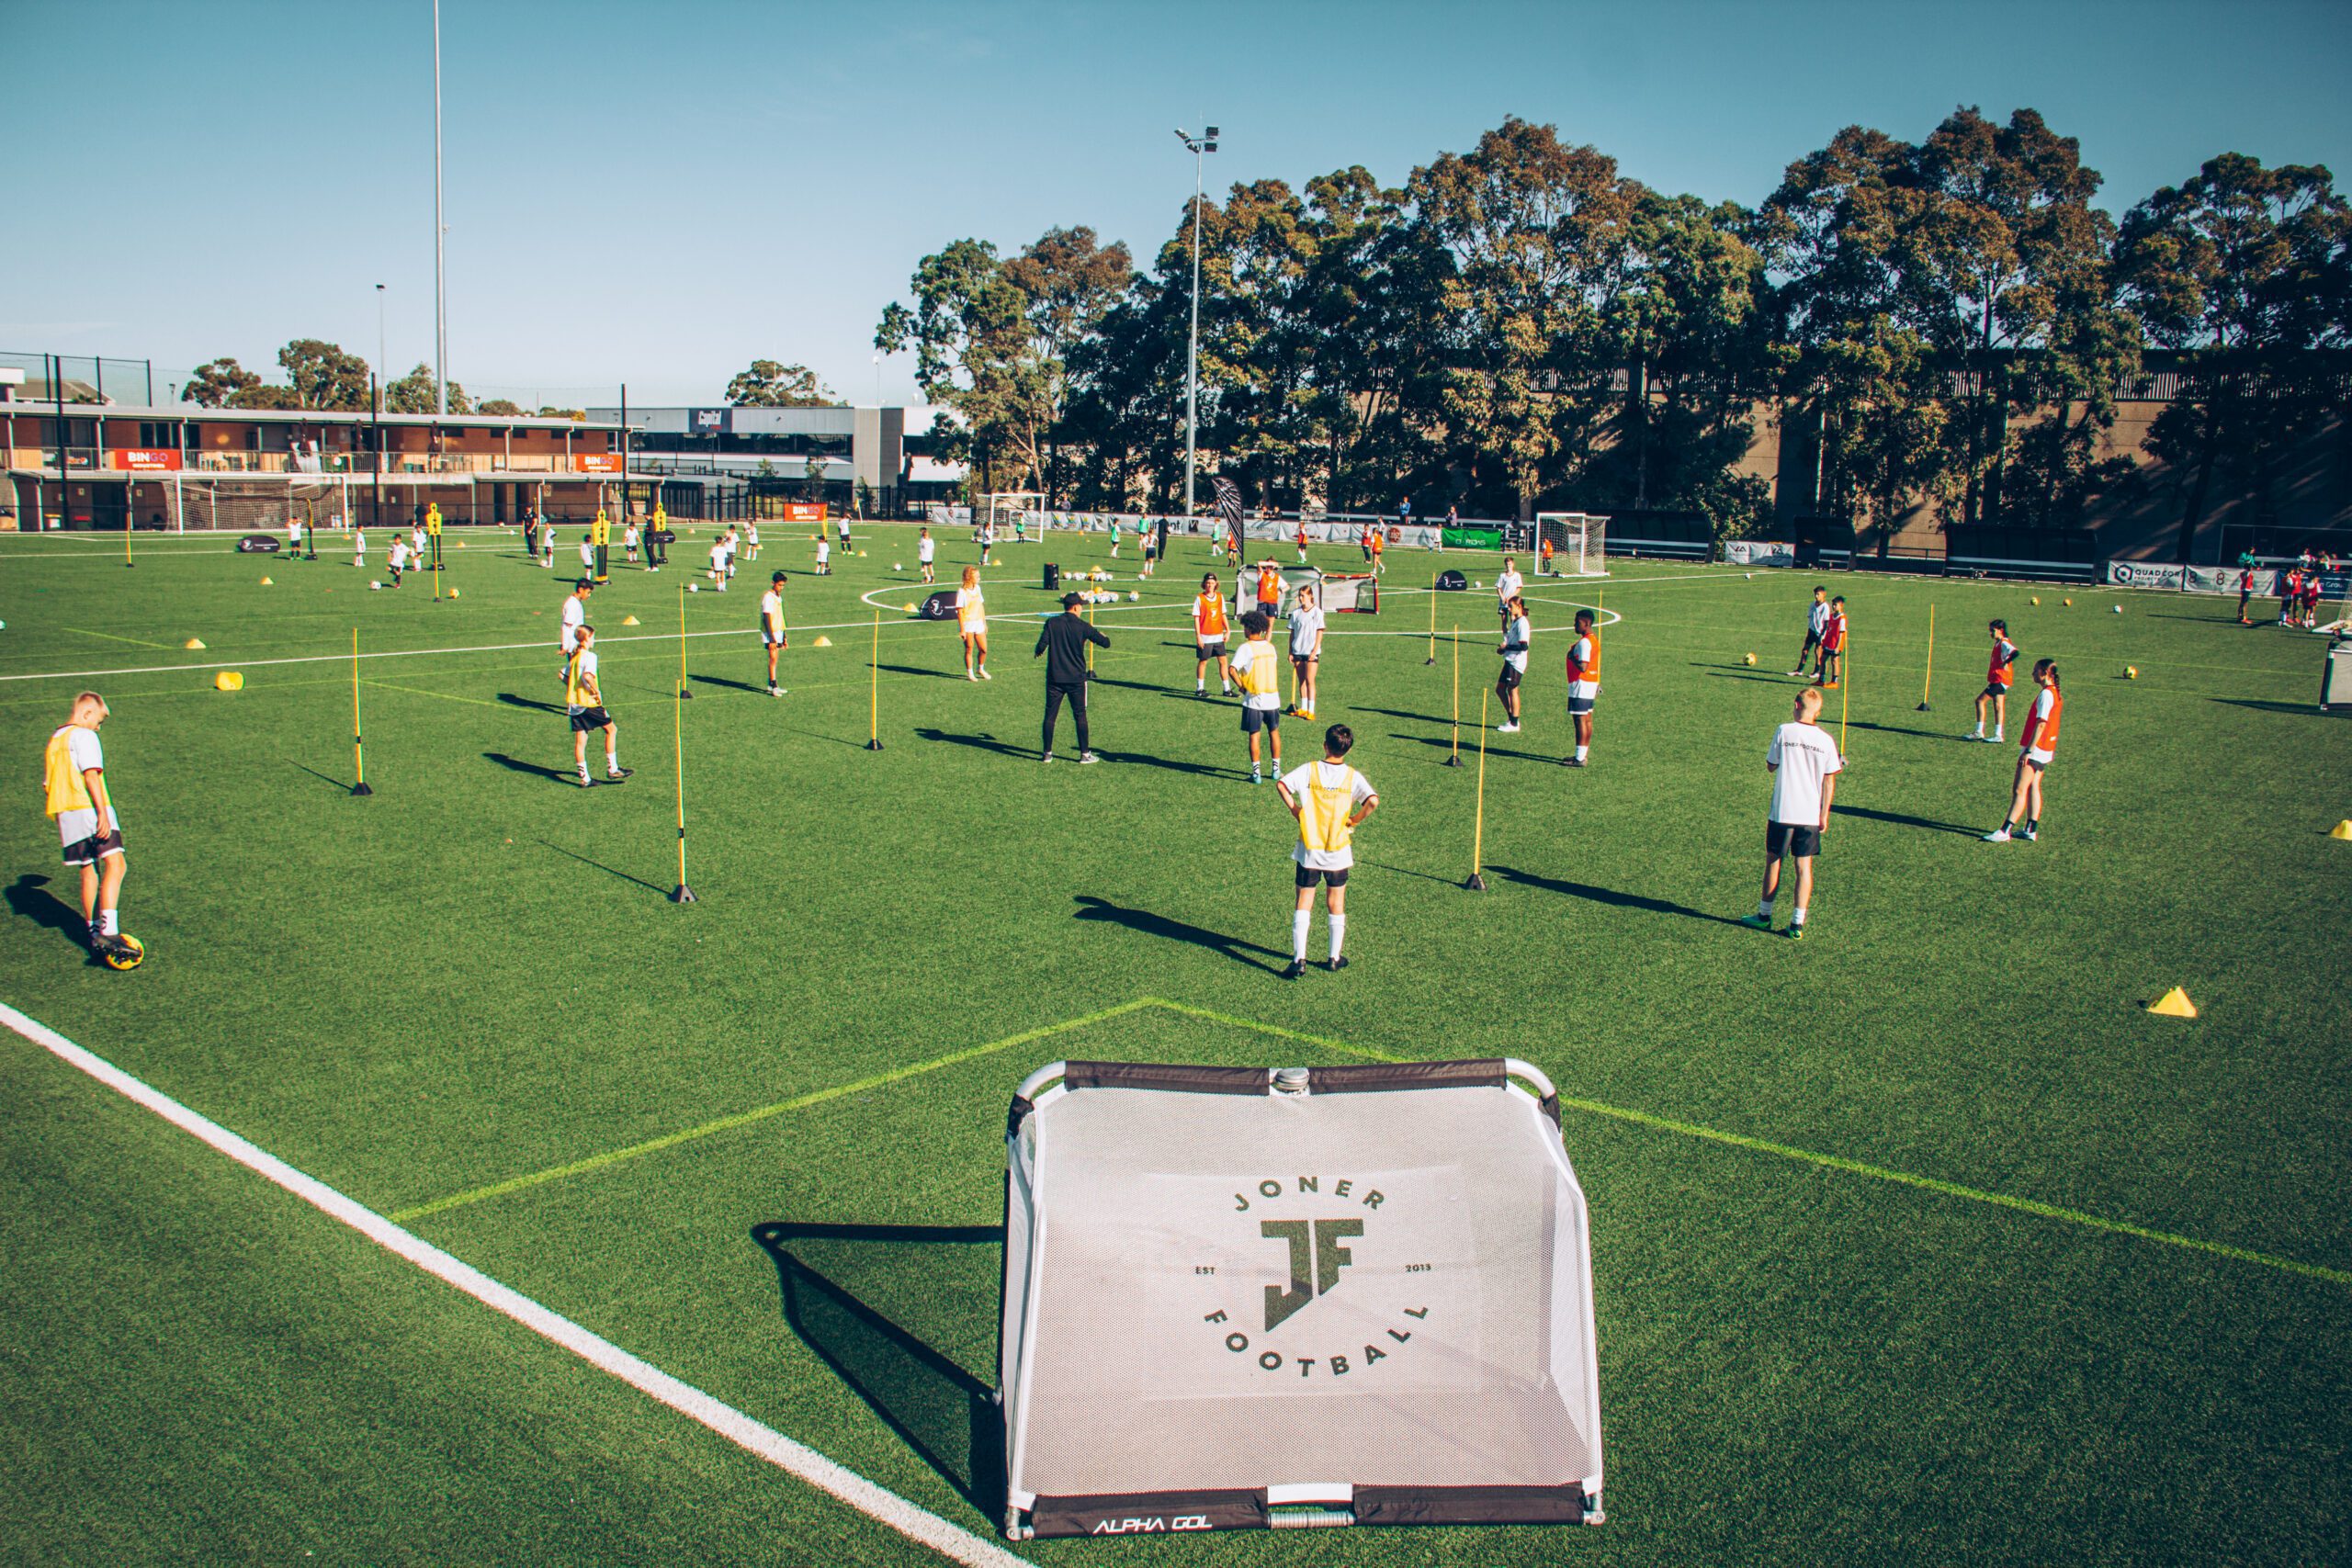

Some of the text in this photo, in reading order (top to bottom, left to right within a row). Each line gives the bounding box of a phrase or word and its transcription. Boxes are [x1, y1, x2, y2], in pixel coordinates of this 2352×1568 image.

[127, 451, 169, 462] BINGO
[584, 456, 615, 466] BINGO
[792, 505, 820, 515] BINGO
[1235, 1176, 1385, 1212] JONER
[1195, 1263, 1431, 1275] EST 2013
[1204, 1306, 1429, 1377] FOOTBALL
[1092, 1515, 1213, 1535] ALPHA GOL
